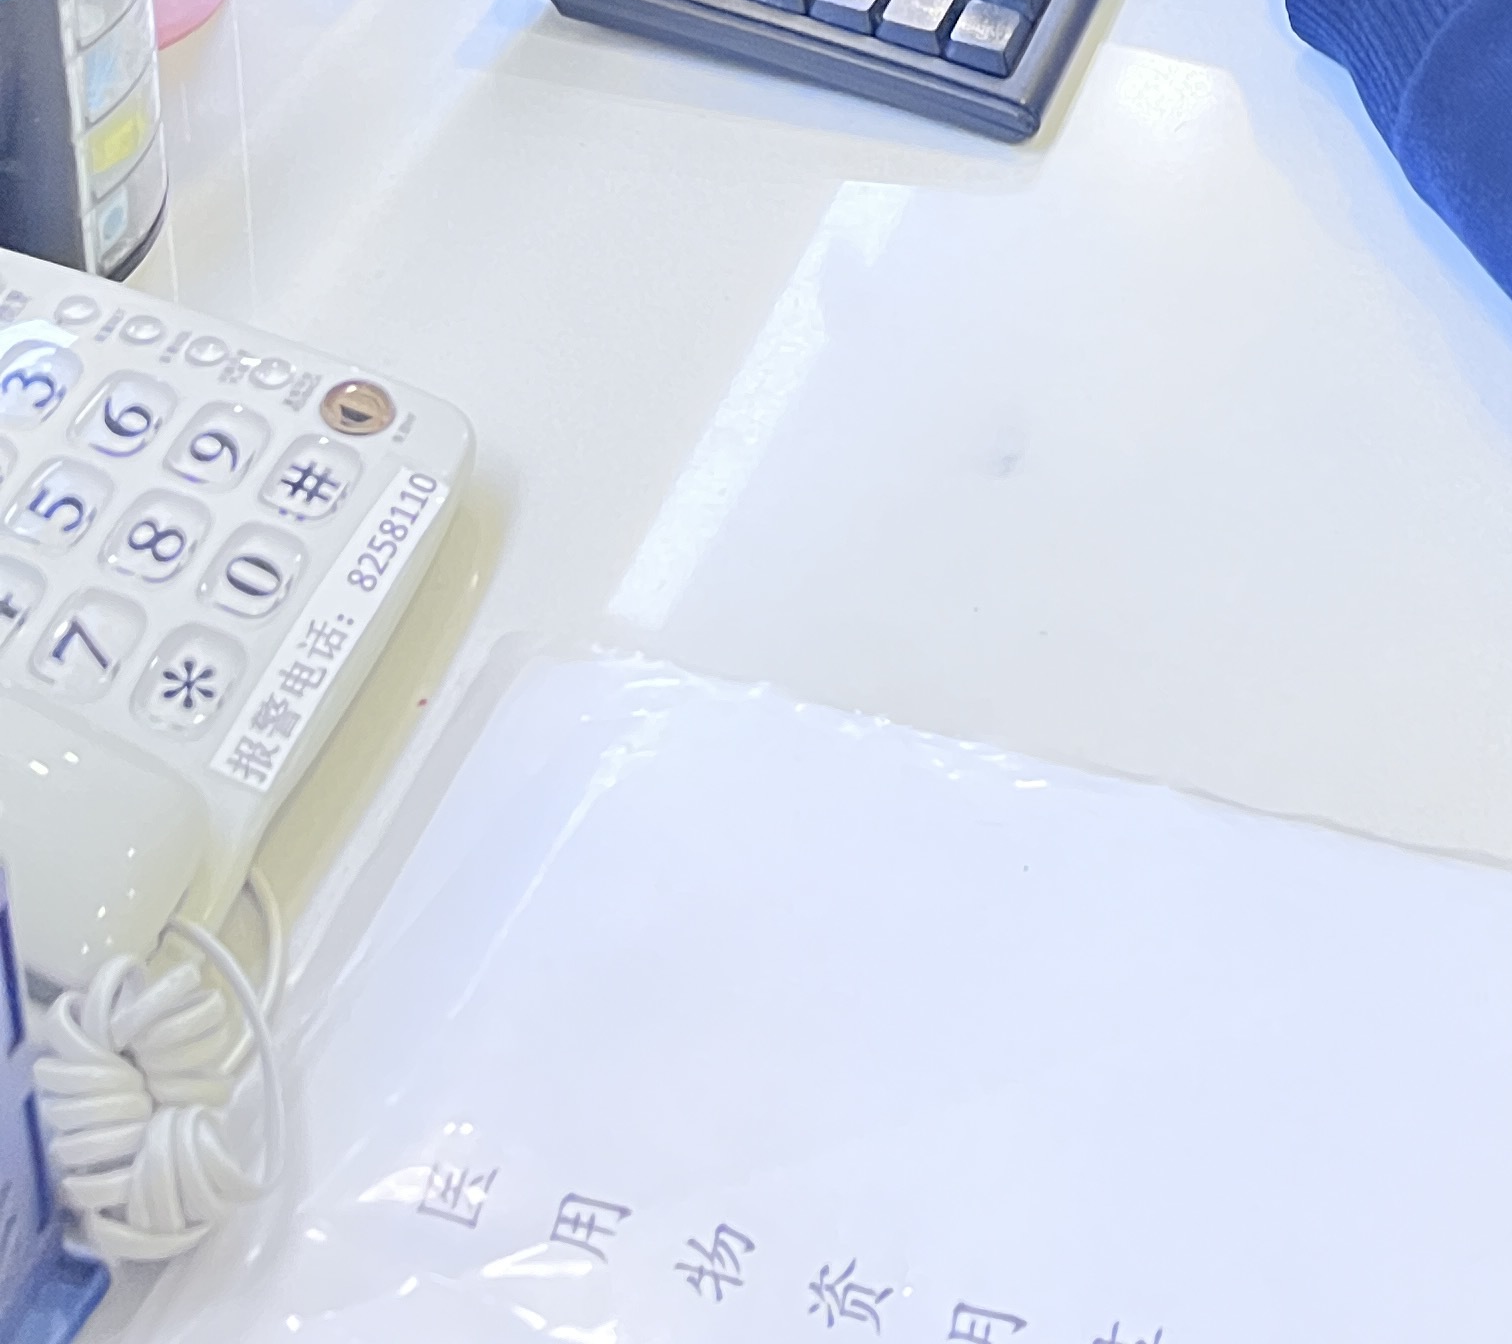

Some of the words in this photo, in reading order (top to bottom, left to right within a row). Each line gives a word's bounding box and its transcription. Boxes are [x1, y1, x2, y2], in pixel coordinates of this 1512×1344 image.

[1, 370, 55, 408] 3
[103, 396, 152, 438] 6
[189, 430, 239, 473] 9
[28, 488, 84, 532] 5
[127, 519, 187, 563] 8
[225, 554, 283, 599] 0
[51, 616, 110, 670] 7
[416, 1163, 1166, 1344] 医用物资
